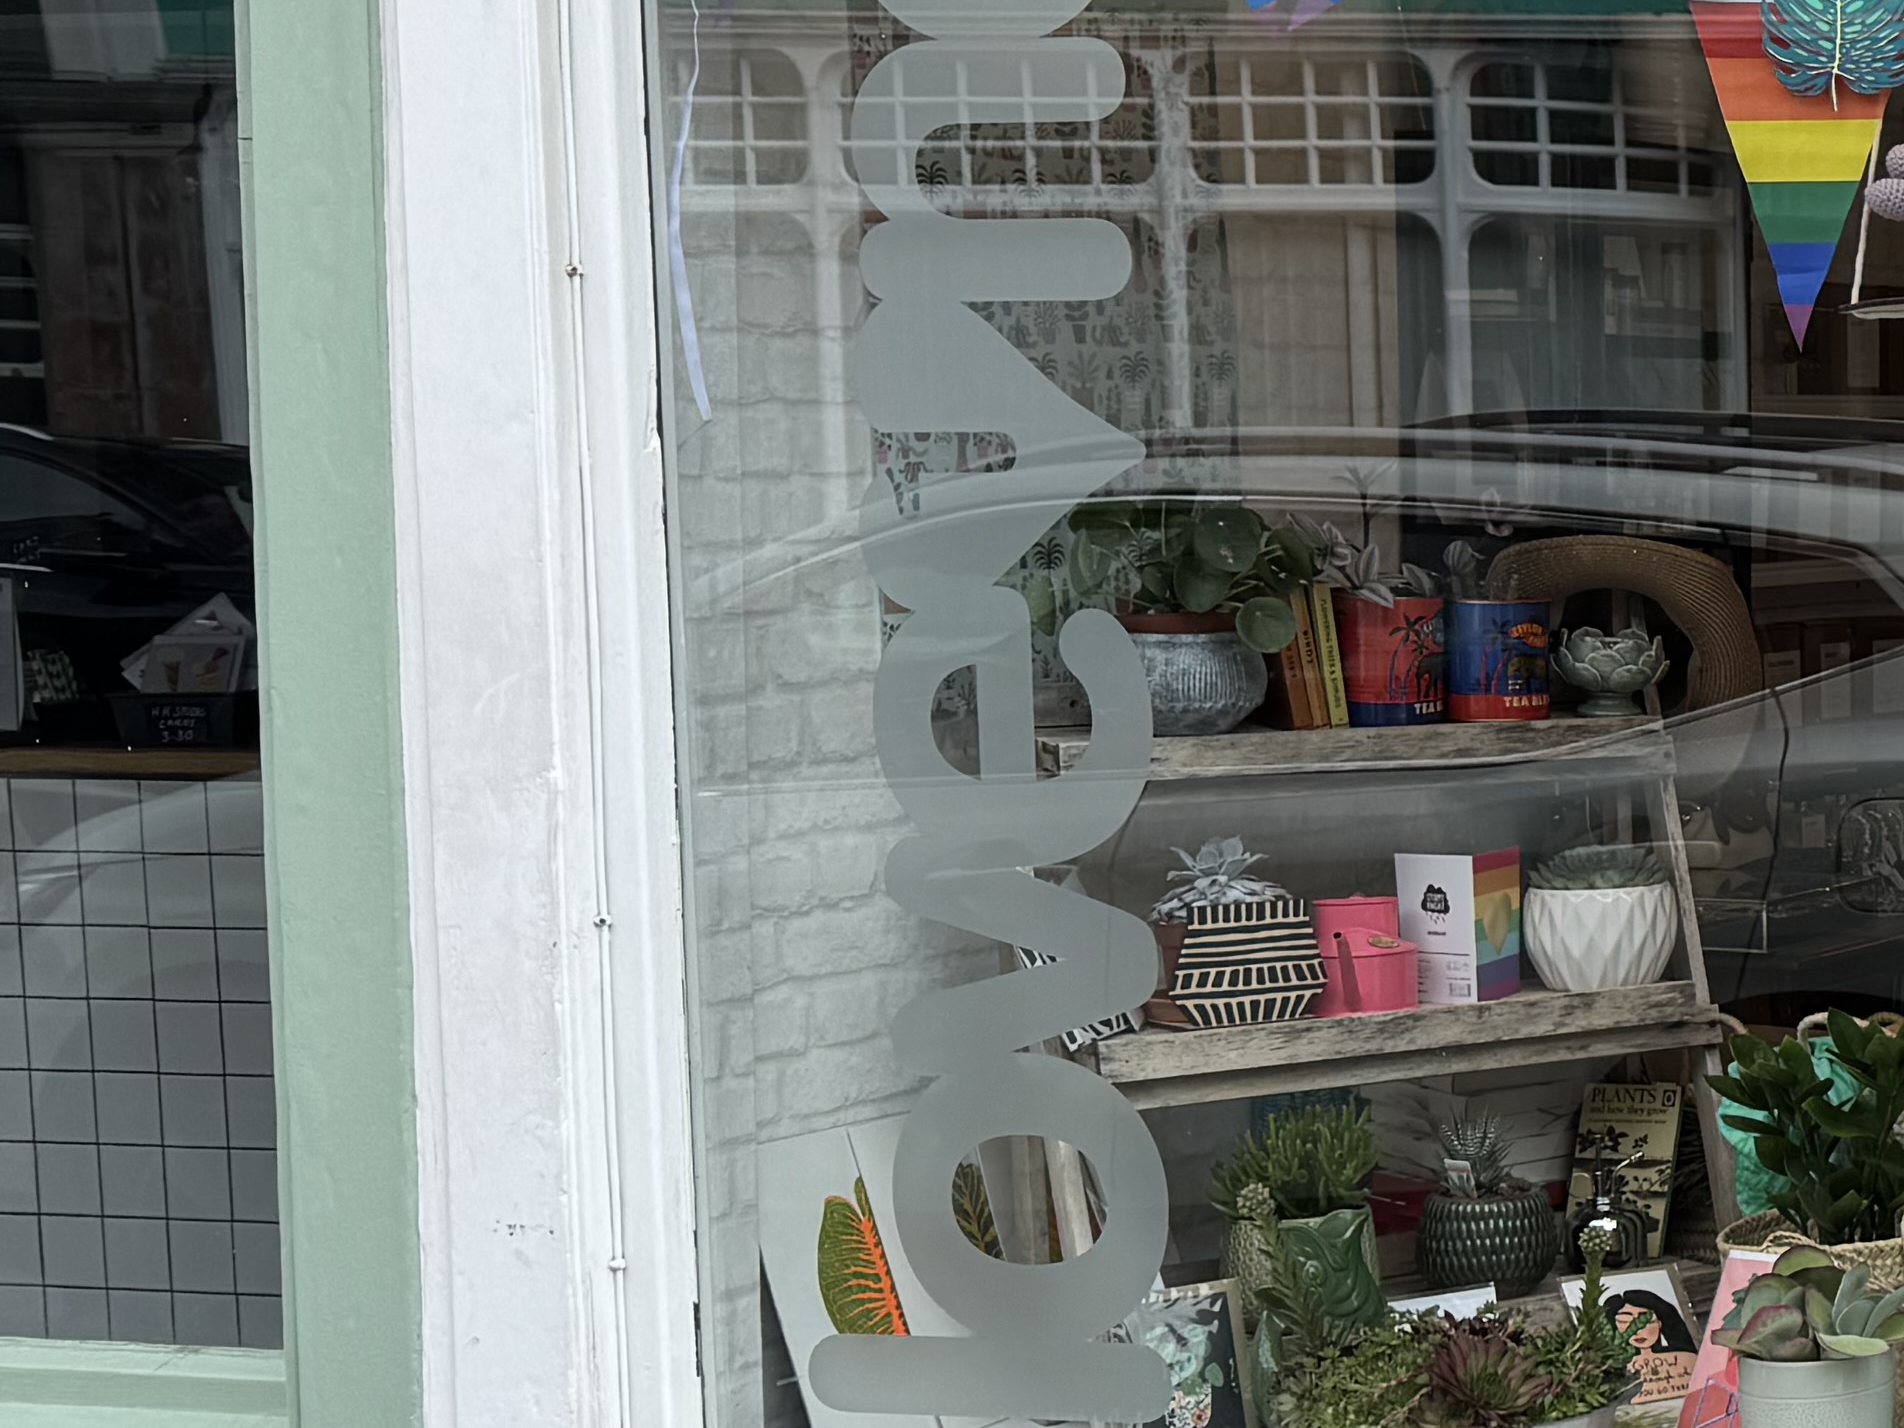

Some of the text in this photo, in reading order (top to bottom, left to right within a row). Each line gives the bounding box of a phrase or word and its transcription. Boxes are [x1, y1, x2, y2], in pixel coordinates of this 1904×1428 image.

[1504, 696, 1530, 708] TEA
[1414, 703, 1437, 715] TEA
[1590, 1086, 1658, 1104] PLANTS
